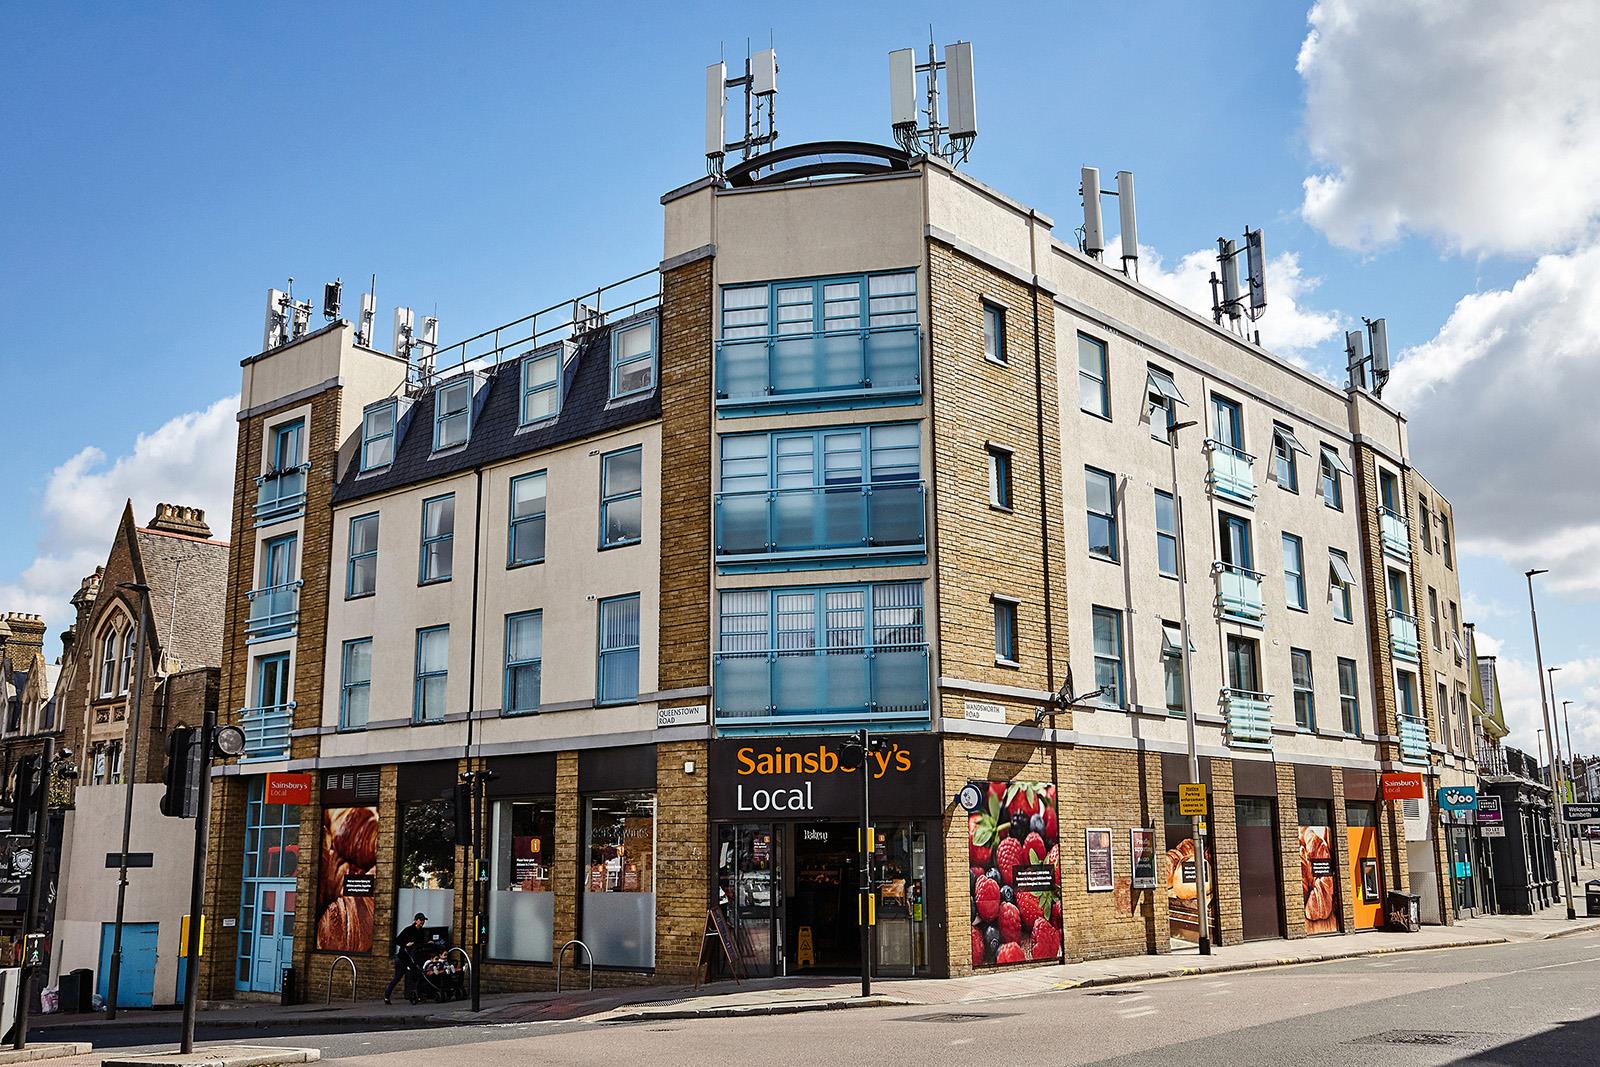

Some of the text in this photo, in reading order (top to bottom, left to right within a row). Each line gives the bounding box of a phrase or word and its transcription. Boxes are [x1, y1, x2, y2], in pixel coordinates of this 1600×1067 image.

[658, 707, 699, 717] QUEENSTOWN
[966, 703, 1000, 713] WANDSWORTH
[965, 711, 980, 719] ROAD
[736, 743, 912, 779] Sainsby's
[271, 781, 308, 791] Sainsbury's
[1384, 780, 1420, 788] Sainsbury's
[270, 789, 287, 797] Local
[736, 781, 814, 811] Local
[804, 829, 828, 843] Bakery
